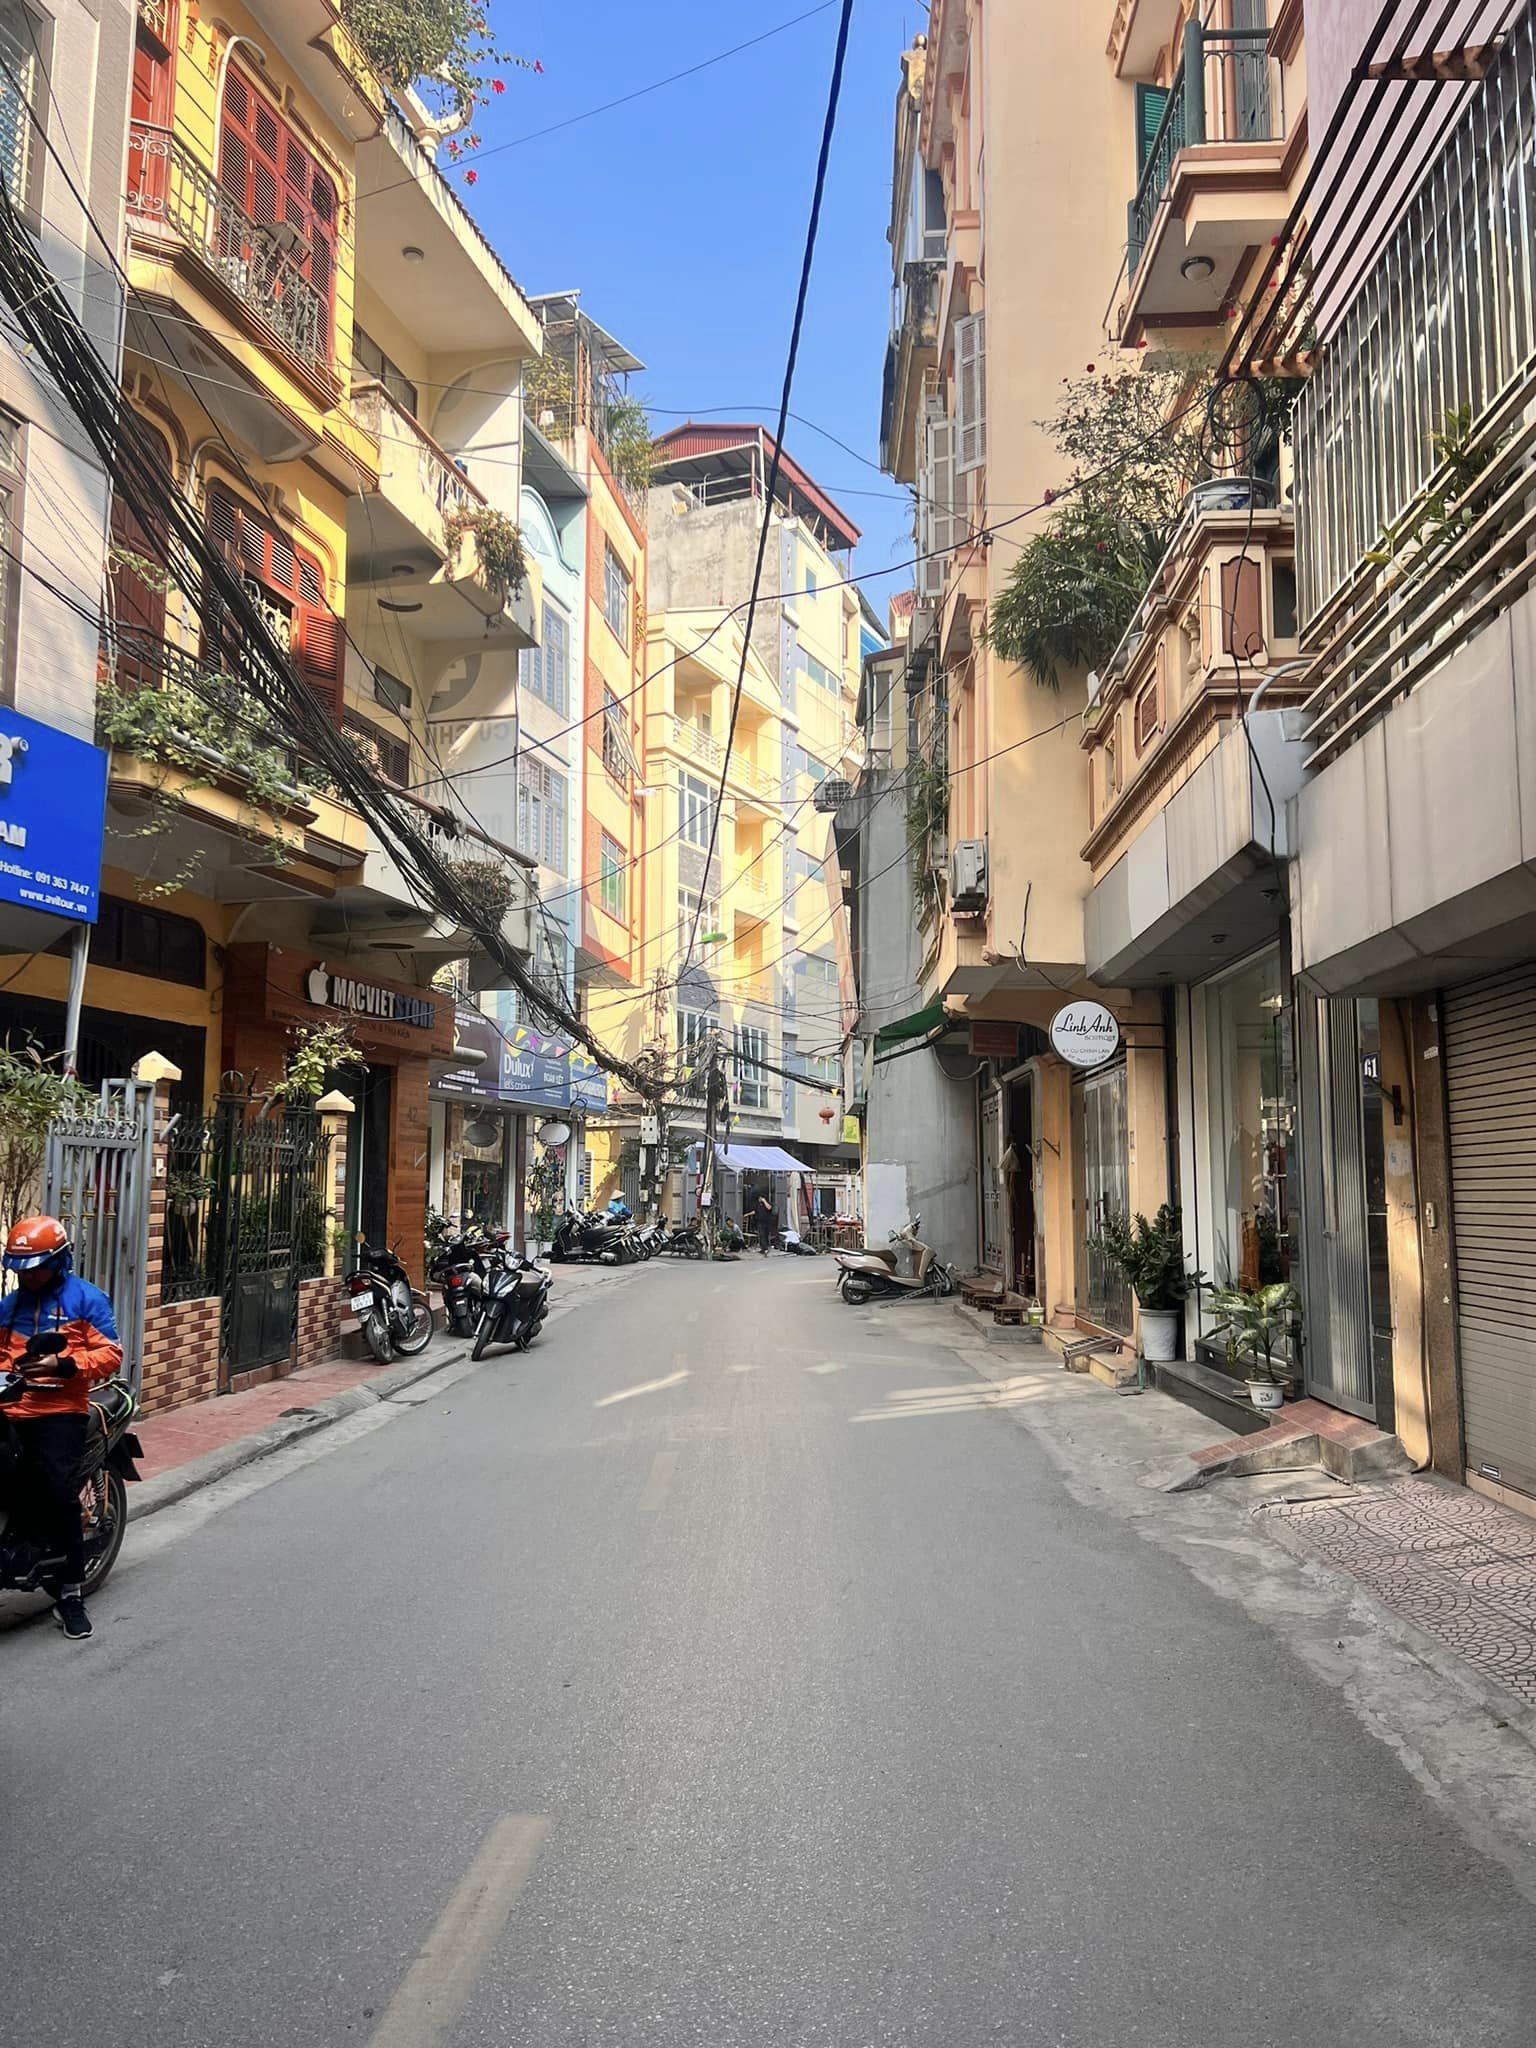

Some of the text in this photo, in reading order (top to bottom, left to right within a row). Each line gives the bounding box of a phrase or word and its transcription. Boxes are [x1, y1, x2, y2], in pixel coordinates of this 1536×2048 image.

[35, 871, 51, 885] 091
[69, 881, 90, 896] 7447
[1055, 1013, 1113, 1035] Linh Anh
[504, 1053, 531, 1079] Dulux
[1364, 1057, 1378, 1078] 61
